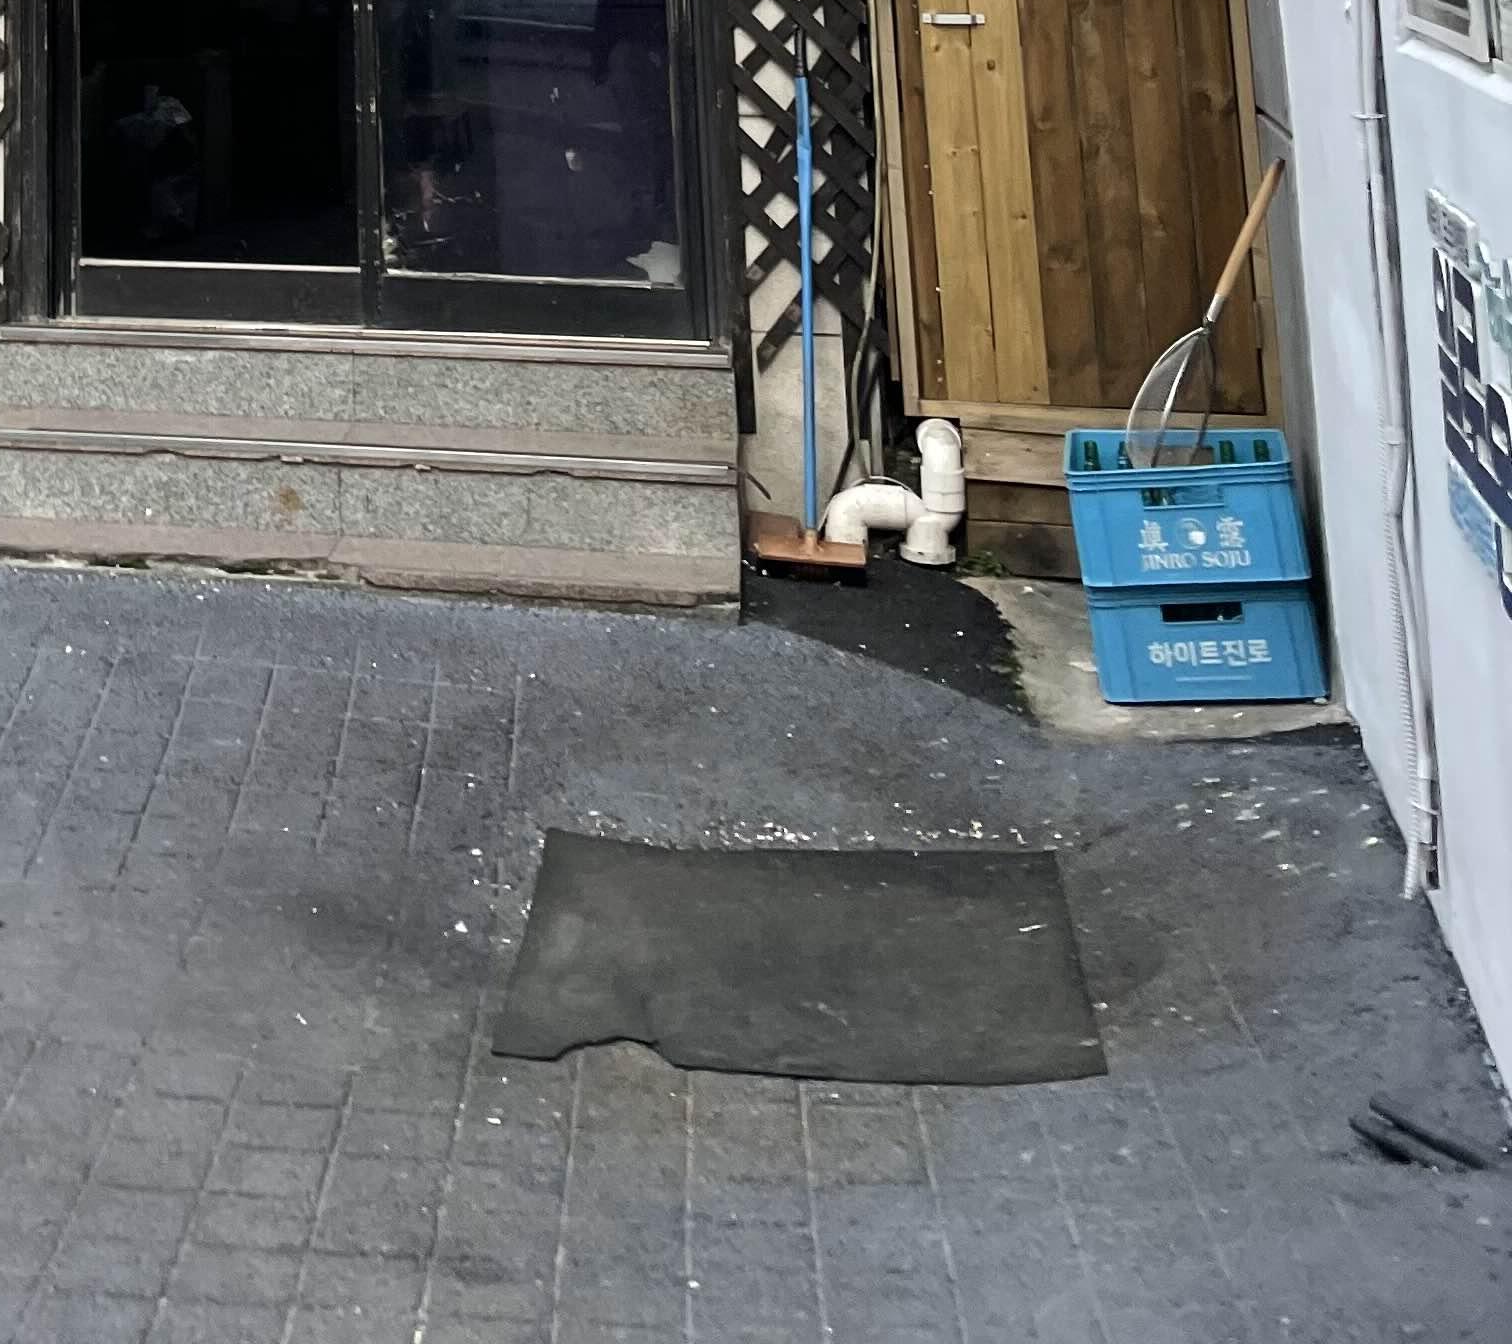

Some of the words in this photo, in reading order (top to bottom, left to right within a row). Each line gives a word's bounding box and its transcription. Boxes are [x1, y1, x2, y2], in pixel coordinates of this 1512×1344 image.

[1141, 552, 1197, 572] JINRO
[1201, 549, 1251, 569] SOJU
[1147, 639, 1272, 668] 하이트진로
